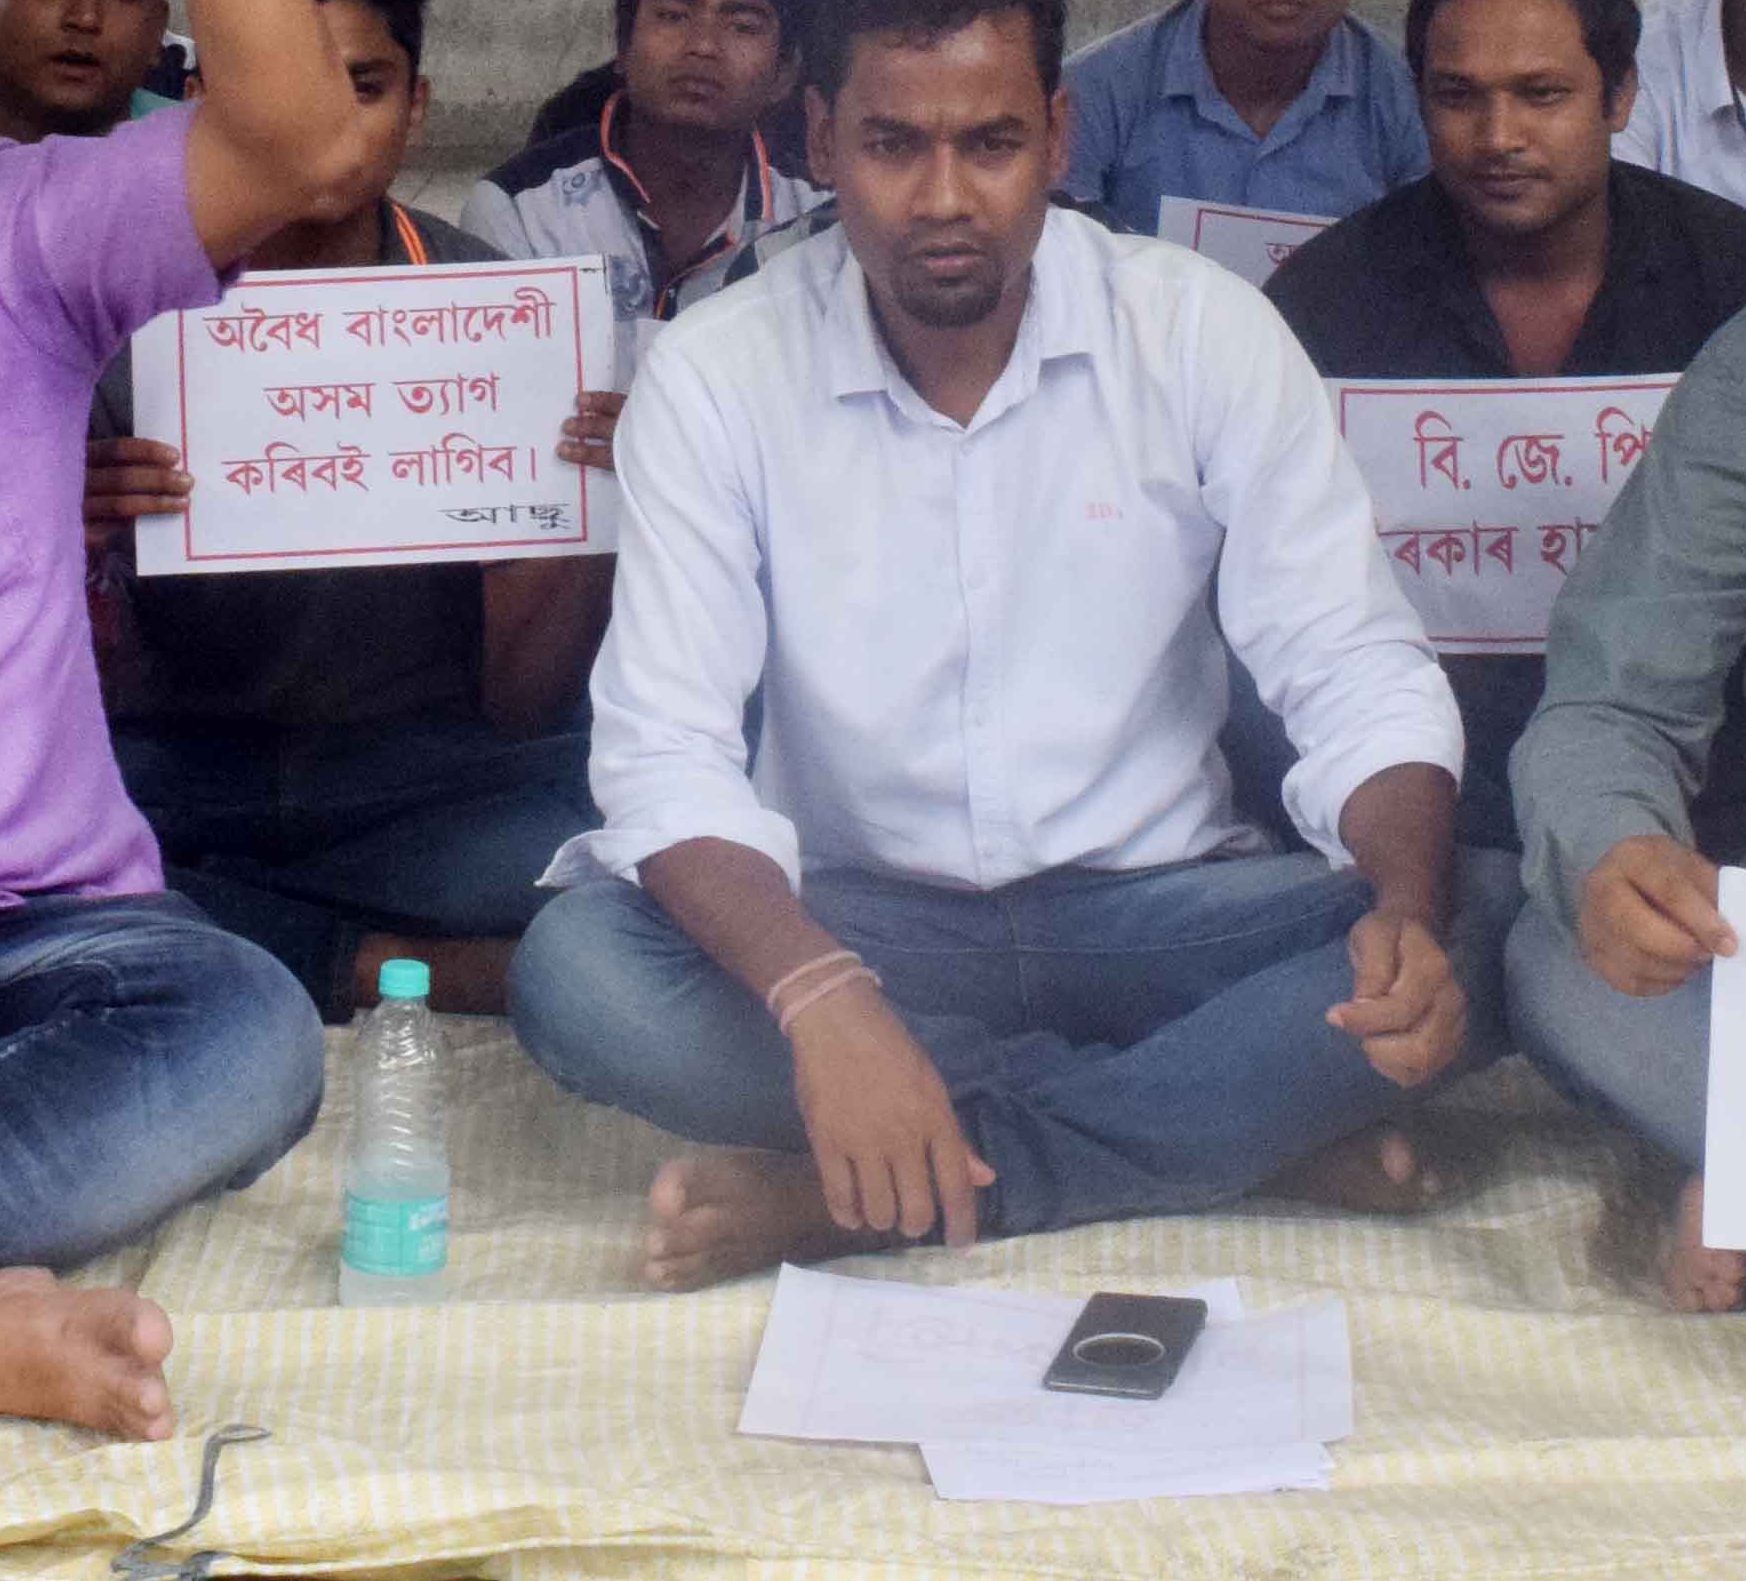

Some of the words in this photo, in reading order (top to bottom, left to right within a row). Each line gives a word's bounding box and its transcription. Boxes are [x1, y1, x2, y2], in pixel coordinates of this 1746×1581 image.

[202, 306, 324, 353] অবৈধ
[344, 286, 557, 347] বাংলাদেশী
[262, 382, 377, 423] অসম
[391, 371, 501, 416] ত্যাগ
[220, 440, 371, 496] কৰিবই
